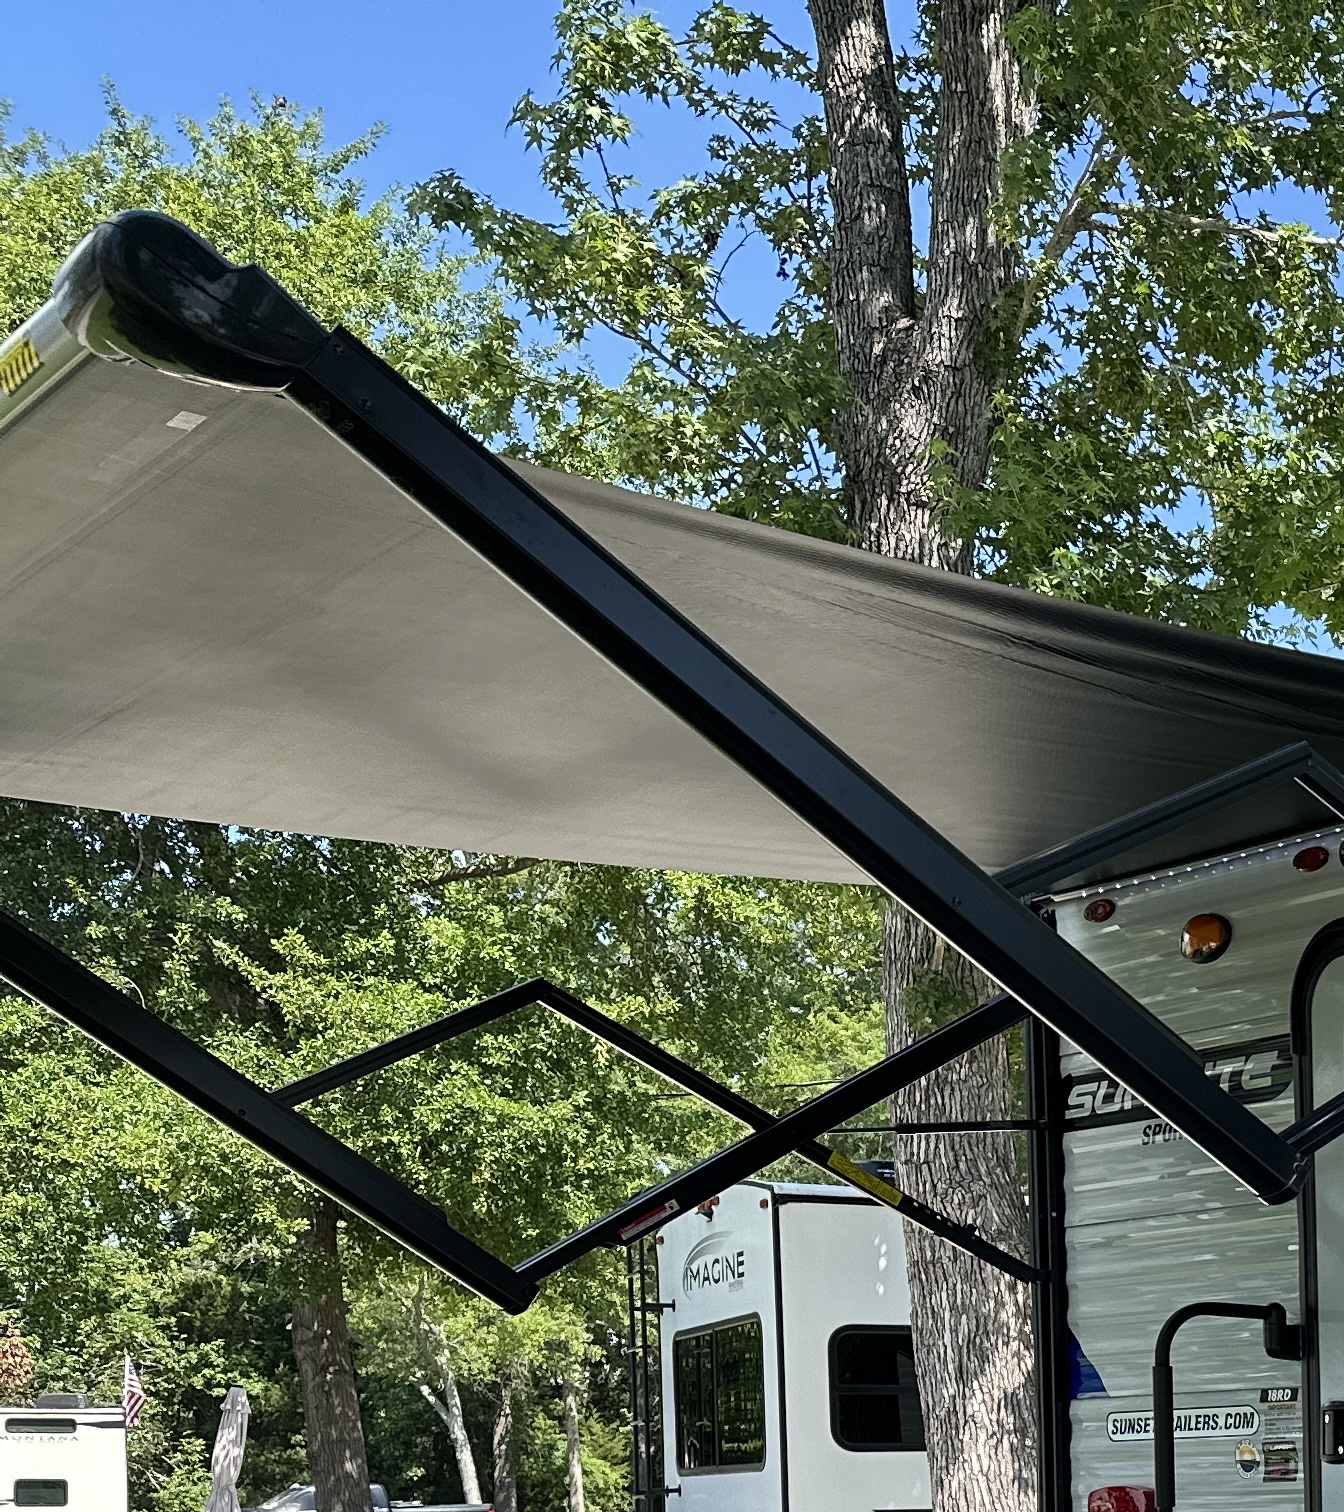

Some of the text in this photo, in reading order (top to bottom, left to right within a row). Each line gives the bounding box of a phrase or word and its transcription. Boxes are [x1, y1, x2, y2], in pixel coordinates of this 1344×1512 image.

[684, 1250, 745, 1292] IMAGINE
[1267, 1388, 1292, 1402] 18RD
[1111, 1411, 1255, 1436] SUNSEAILERS.COM
